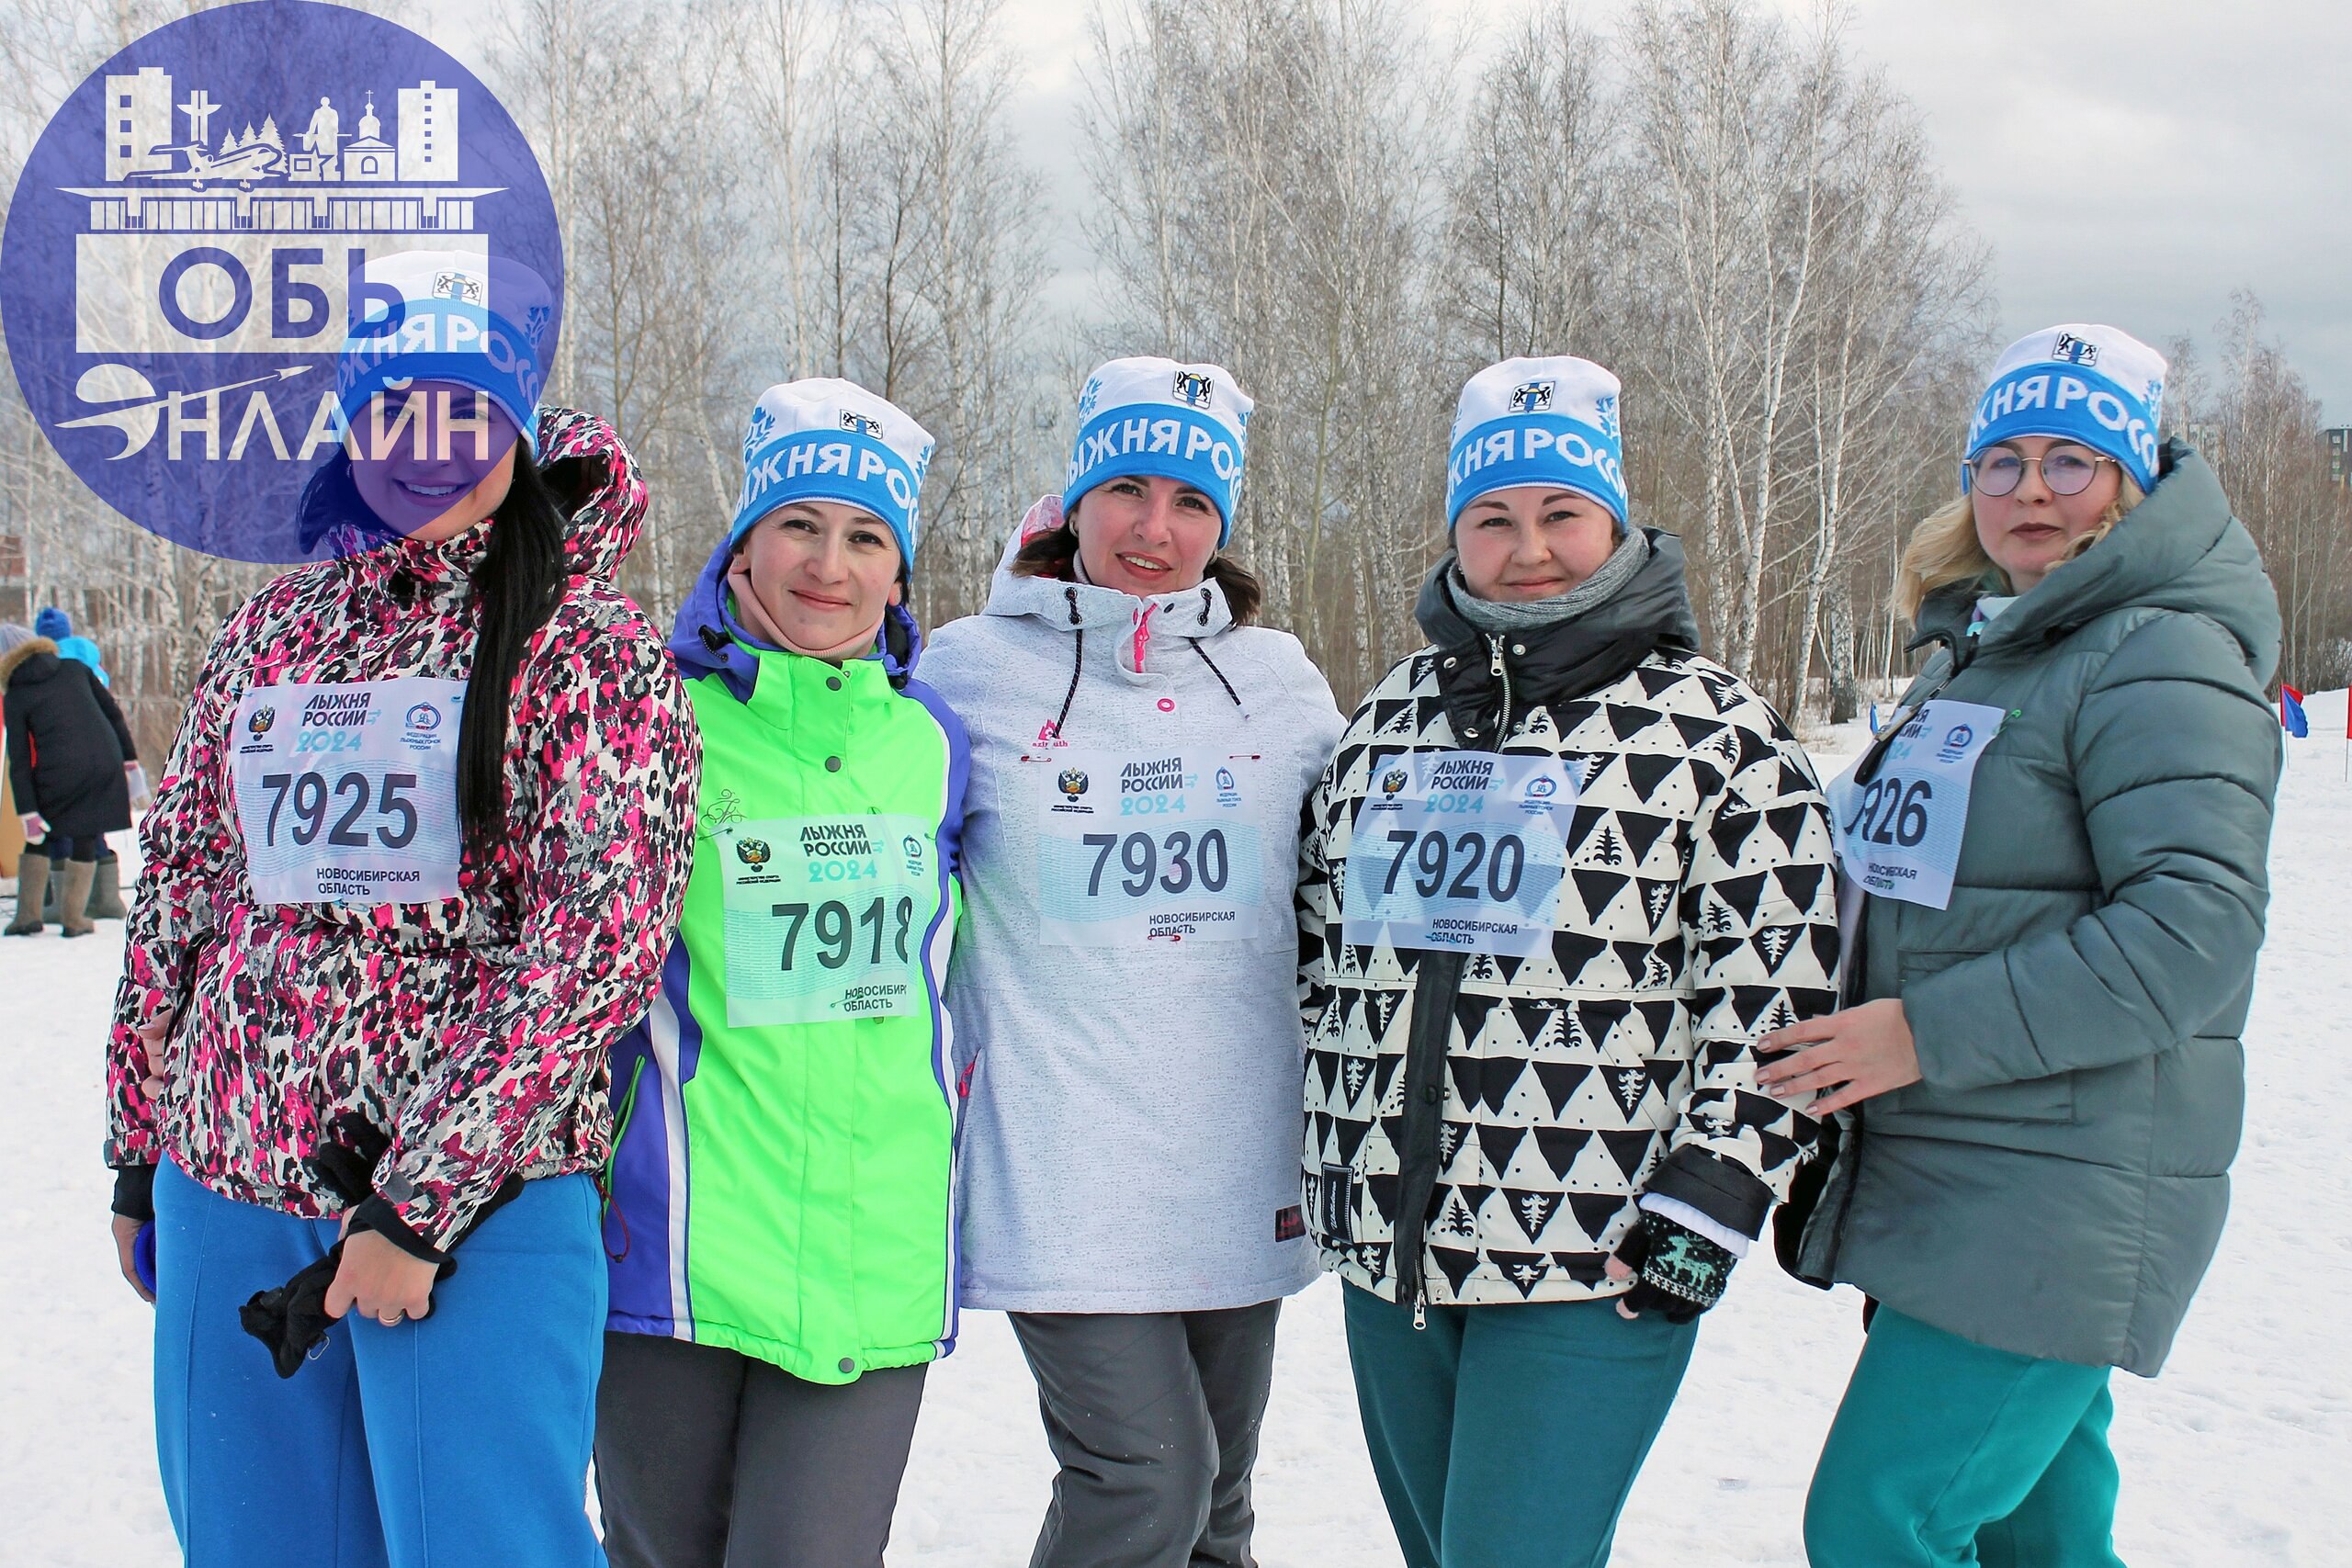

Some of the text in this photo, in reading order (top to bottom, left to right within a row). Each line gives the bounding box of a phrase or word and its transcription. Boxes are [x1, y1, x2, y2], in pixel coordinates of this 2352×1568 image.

[305, 693, 371, 709] ЛЫЖНЯ
[302, 710, 366, 727] РОССИИ
[295, 730, 362, 751] 2024
[1120, 757, 1182, 778] ЛЫЖНЯ
[1434, 760, 1494, 775] ЛЫЖНЯ
[1121, 774, 1183, 793] РОССИИ
[1430, 776, 1489, 790] РОССИИ
[263, 772, 418, 849] 7925
[1120, 794, 1186, 816] 2024
[1424, 794, 1484, 814] 2024
[800, 824, 866, 841] ЛЫЖНЯ
[804, 840, 872, 857] РОССИИ
[808, 859, 877, 883] 2024
[1083, 829, 1228, 897] 7930
[1384, 830, 1524, 903] 7920
[317, 868, 420, 882] НОВОСИБИРСКАЯ
[318, 883, 370, 896] ОБЛАСТЬ
[1149, 911, 1235, 925] НОВОСИБИРСКАЯ
[1432, 919, 1518, 934] НОВОСИБИРСКАЯ
[772, 896, 912, 971] 7918
[1149, 924, 1196, 937] ОБЛАСТЬ
[844, 998, 893, 1011] ОБЛАСТЬ
